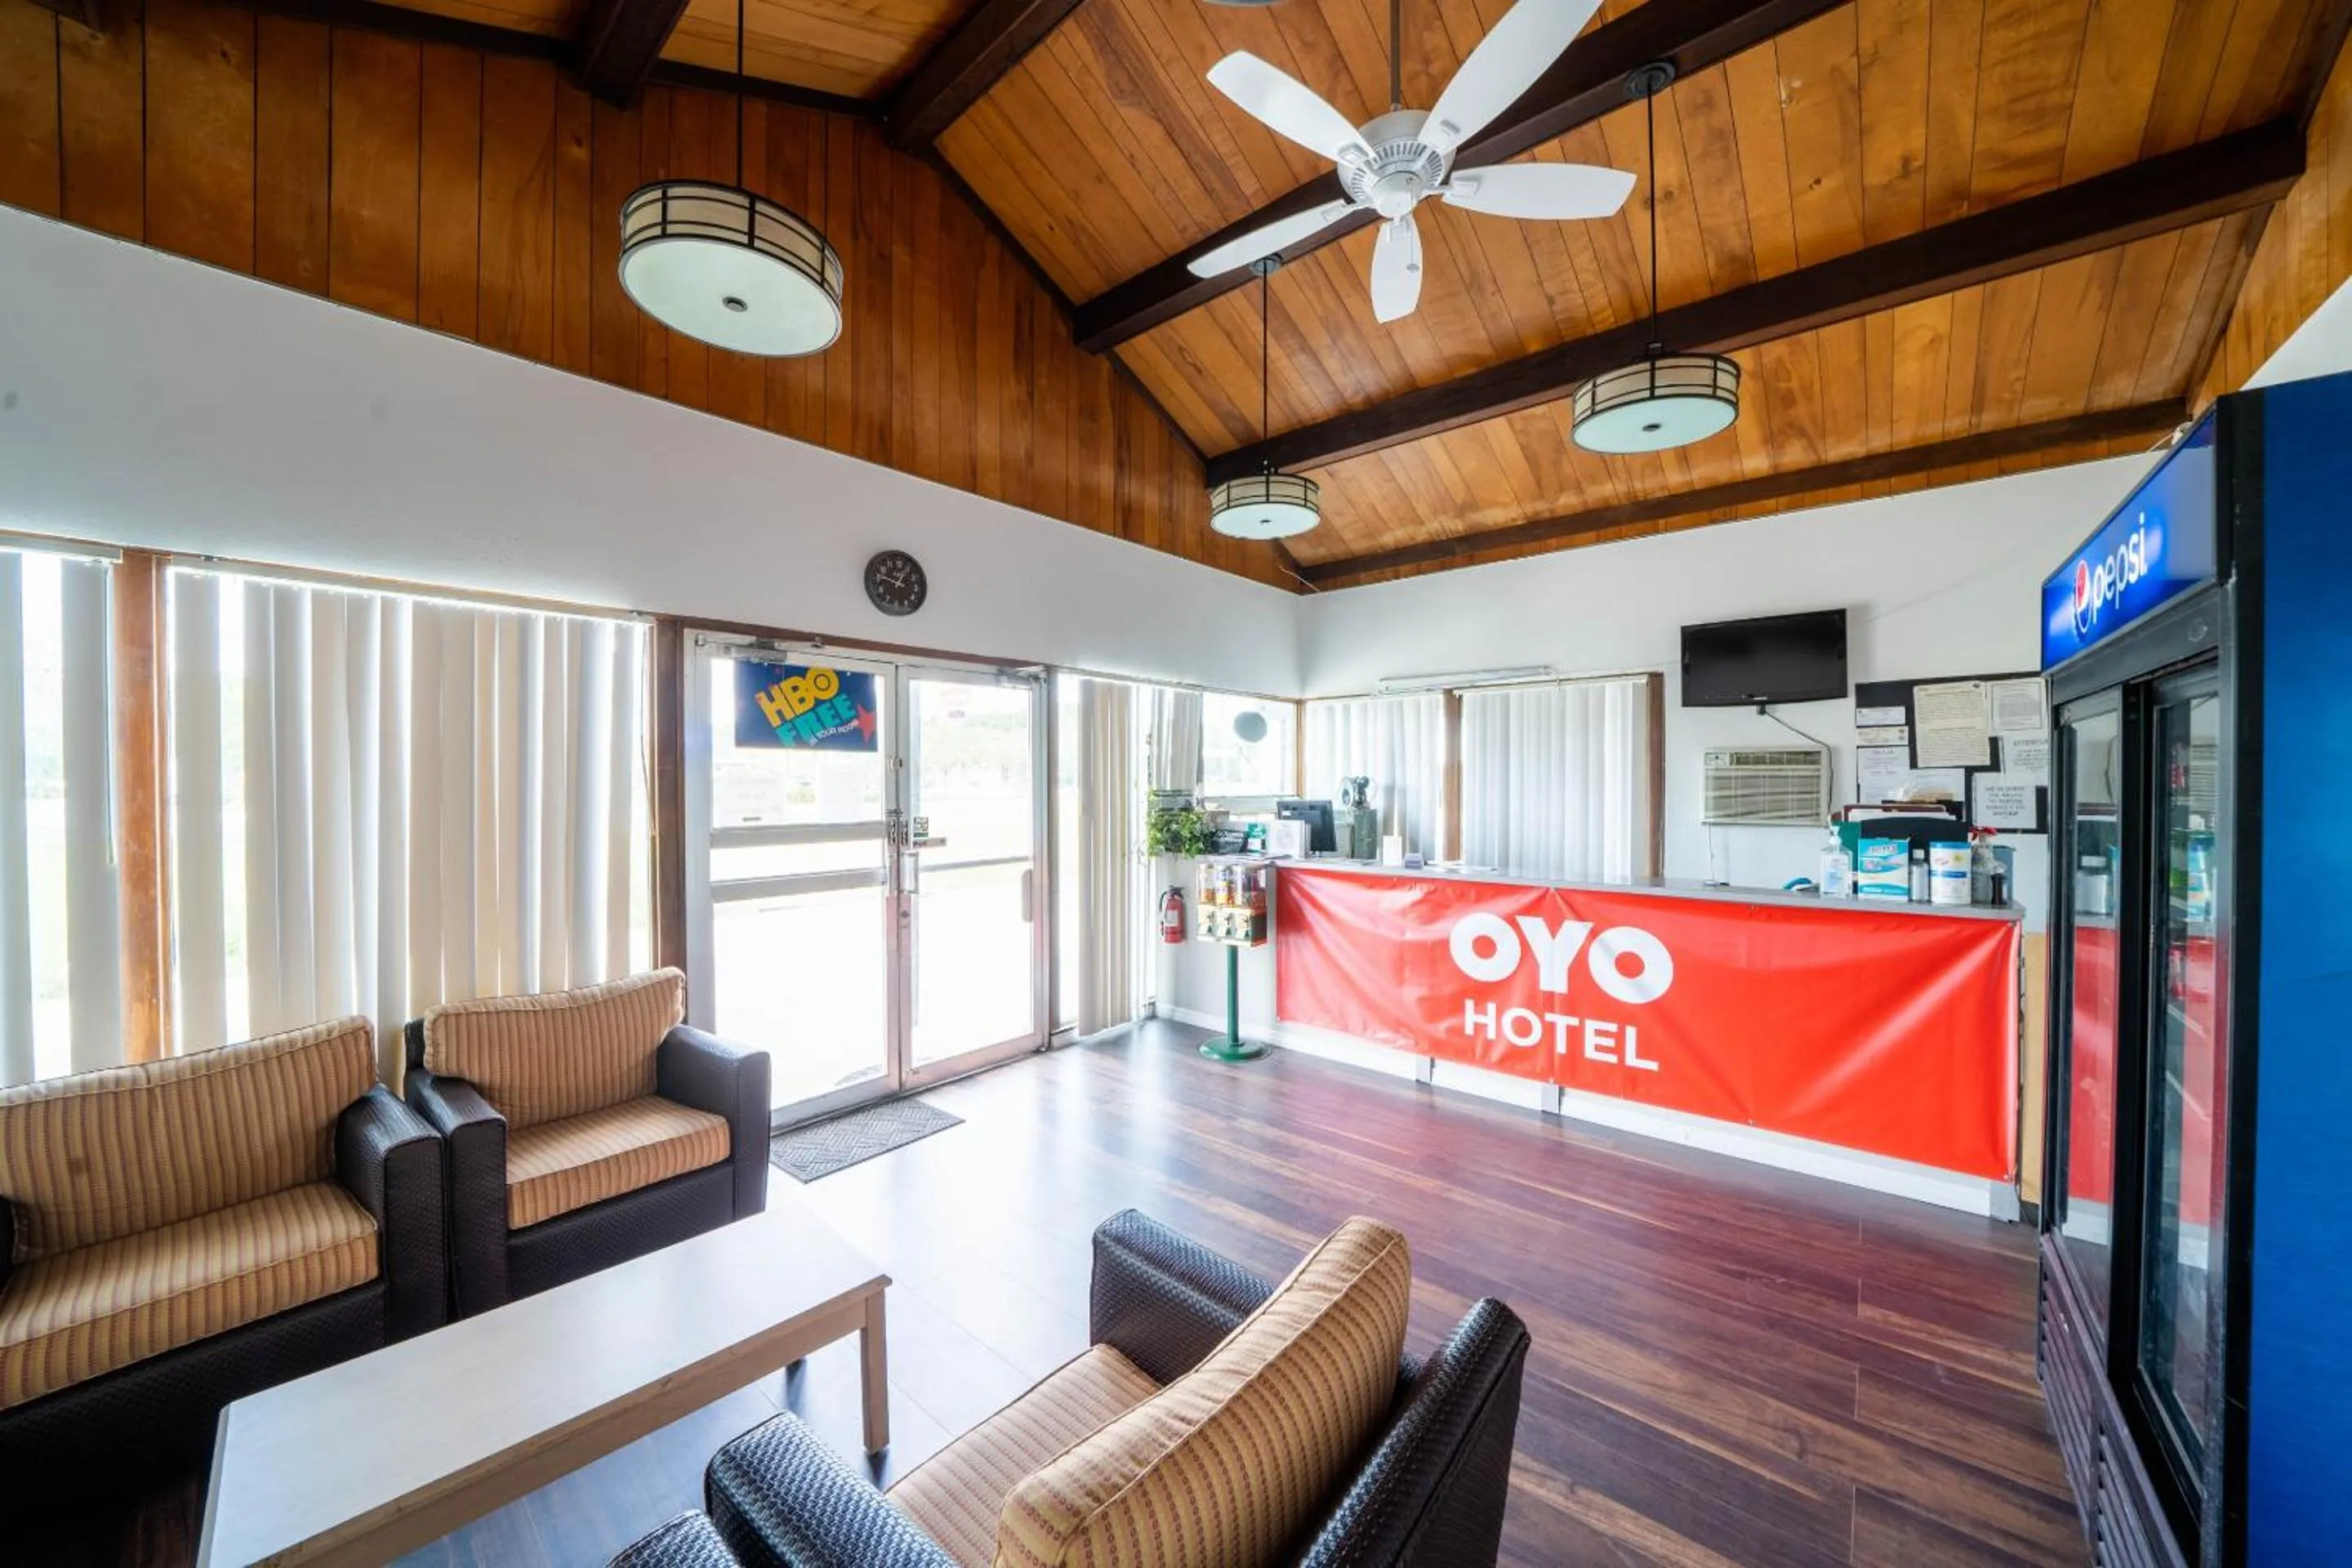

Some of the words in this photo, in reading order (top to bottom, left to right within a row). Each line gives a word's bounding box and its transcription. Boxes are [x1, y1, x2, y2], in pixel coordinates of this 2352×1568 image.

[2092, 511, 2146, 626] pepsi
[755, 666, 840, 728] HBO
[775, 693, 857, 747] FREE
[1449, 912, 1673, 1004] OYO
[1463, 999, 1659, 1071] HOTEL
